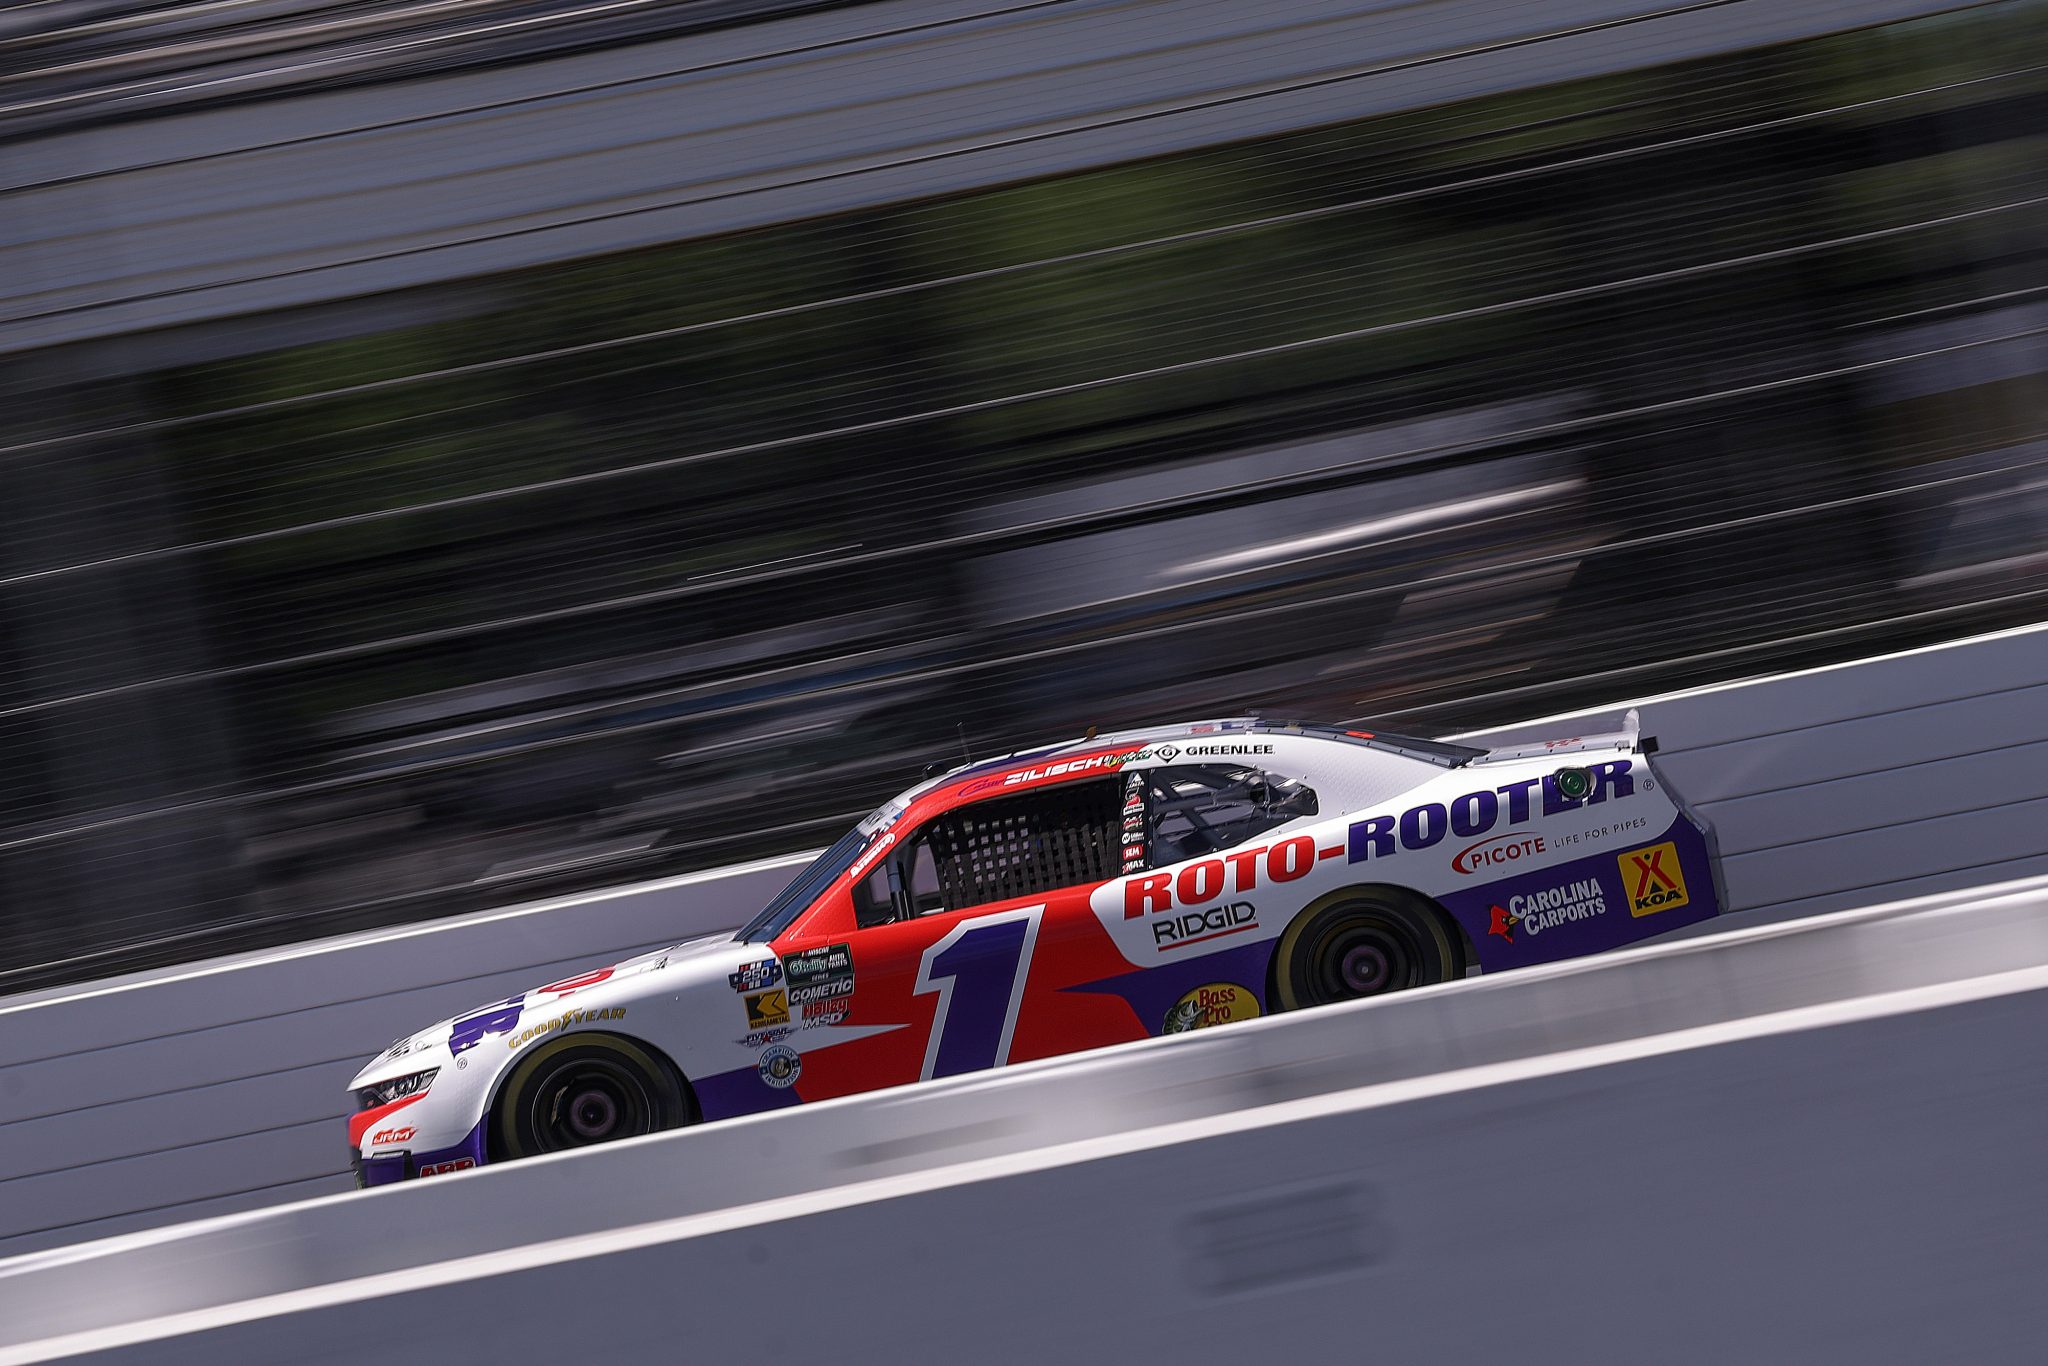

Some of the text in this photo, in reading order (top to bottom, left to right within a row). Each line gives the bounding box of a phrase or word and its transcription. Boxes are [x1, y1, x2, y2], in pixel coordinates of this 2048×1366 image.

[1185, 744, 1274, 756] GREENLEE
[1003, 755, 1104, 786] ZILISCH
[1472, 817, 1647, 870] PICOTE LIFE FOR PIPES
[1509, 877, 1604, 919] CAROLINA
[1635, 889, 1683, 911] KOA
[1152, 900, 1257, 944] RIDGID
[1524, 898, 1606, 935] CARPORTS
[742, 966, 770, 982] 250
[790, 976, 853, 1002] COMETIC
[913, 903, 1047, 1083] 1
[1199, 987, 1236, 1009] Bass
[802, 998, 848, 1018] Holley
[1202, 1005, 1232, 1024] Pro
[507, 1006, 627, 1050] GOODYEAR
